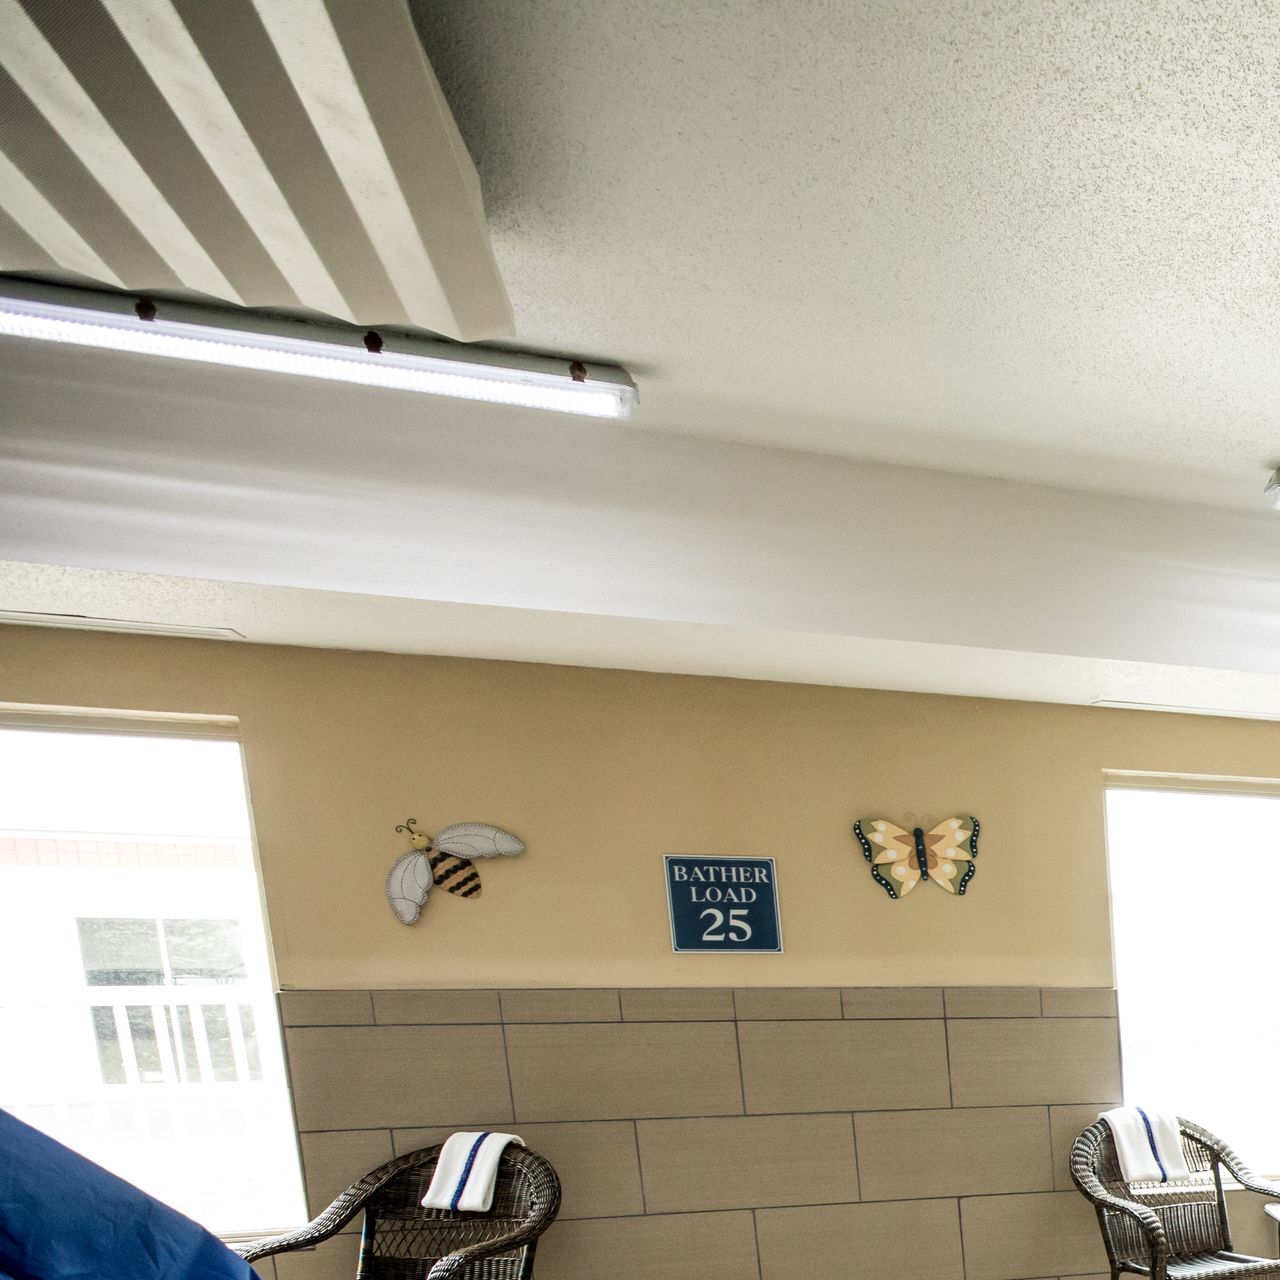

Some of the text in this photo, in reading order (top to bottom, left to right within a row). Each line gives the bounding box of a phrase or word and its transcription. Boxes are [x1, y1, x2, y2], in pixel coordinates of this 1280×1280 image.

[672, 865, 769, 883] BATHER
[690, 886, 757, 903] LOAD
[699, 908, 752, 941] 25
